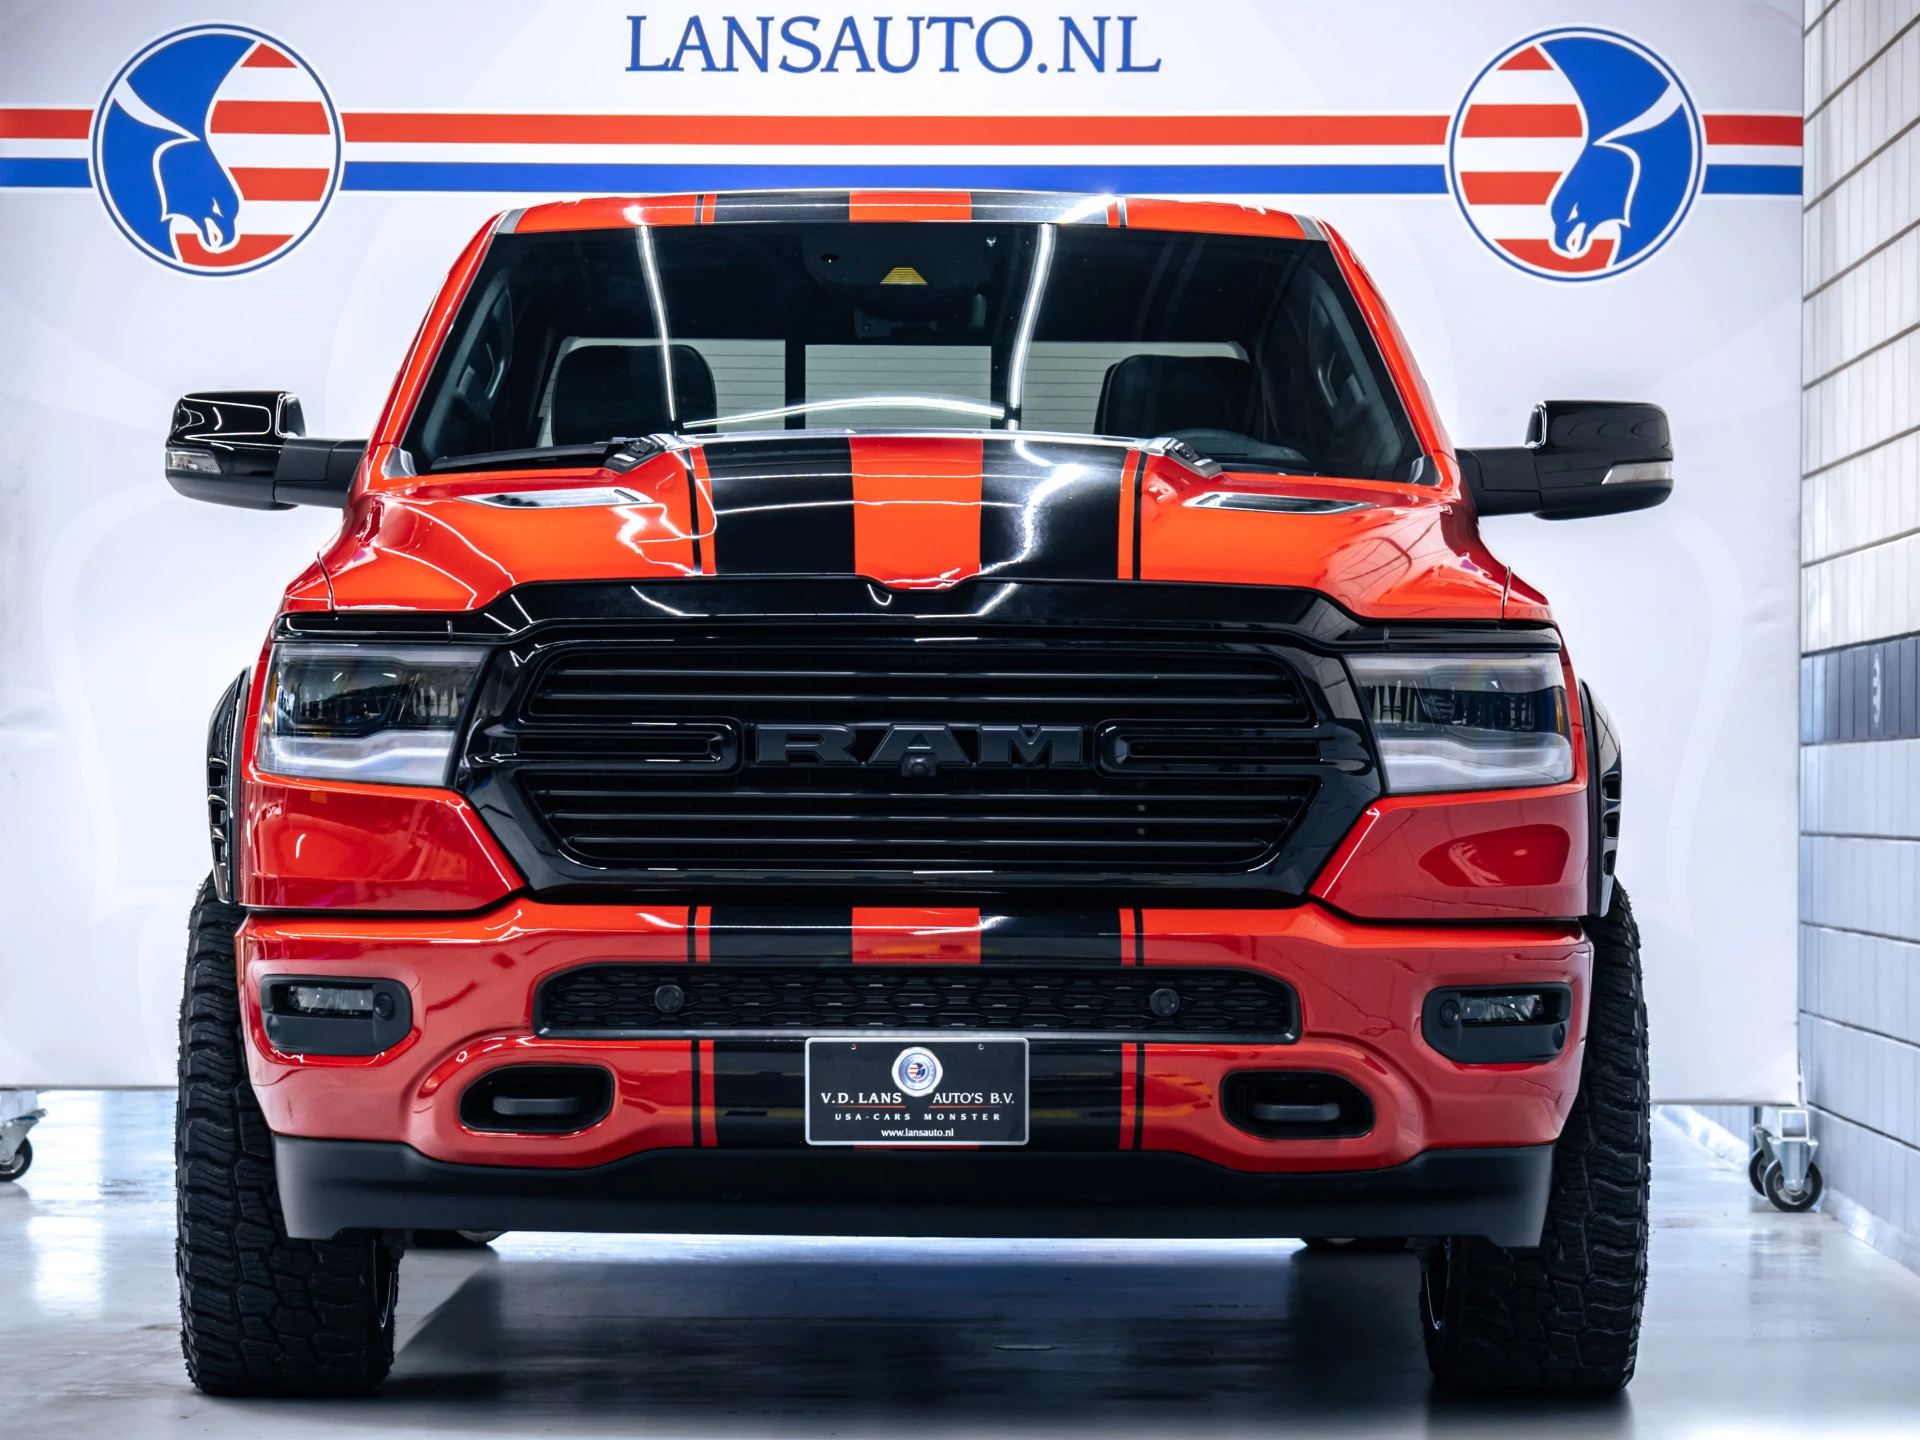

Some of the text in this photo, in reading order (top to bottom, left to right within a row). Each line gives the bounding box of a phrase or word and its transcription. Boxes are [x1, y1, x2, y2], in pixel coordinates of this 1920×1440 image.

[625, 15, 1162, 73] LANSAUTO.NL
[755, 723, 1084, 765] RAM
[821, 1092, 1014, 1104] V.D. LANS AUTO'S B.V.
[924, 1113, 1000, 1121] MONSTER
[881, 1128, 954, 1138] www.lansauto.nl
